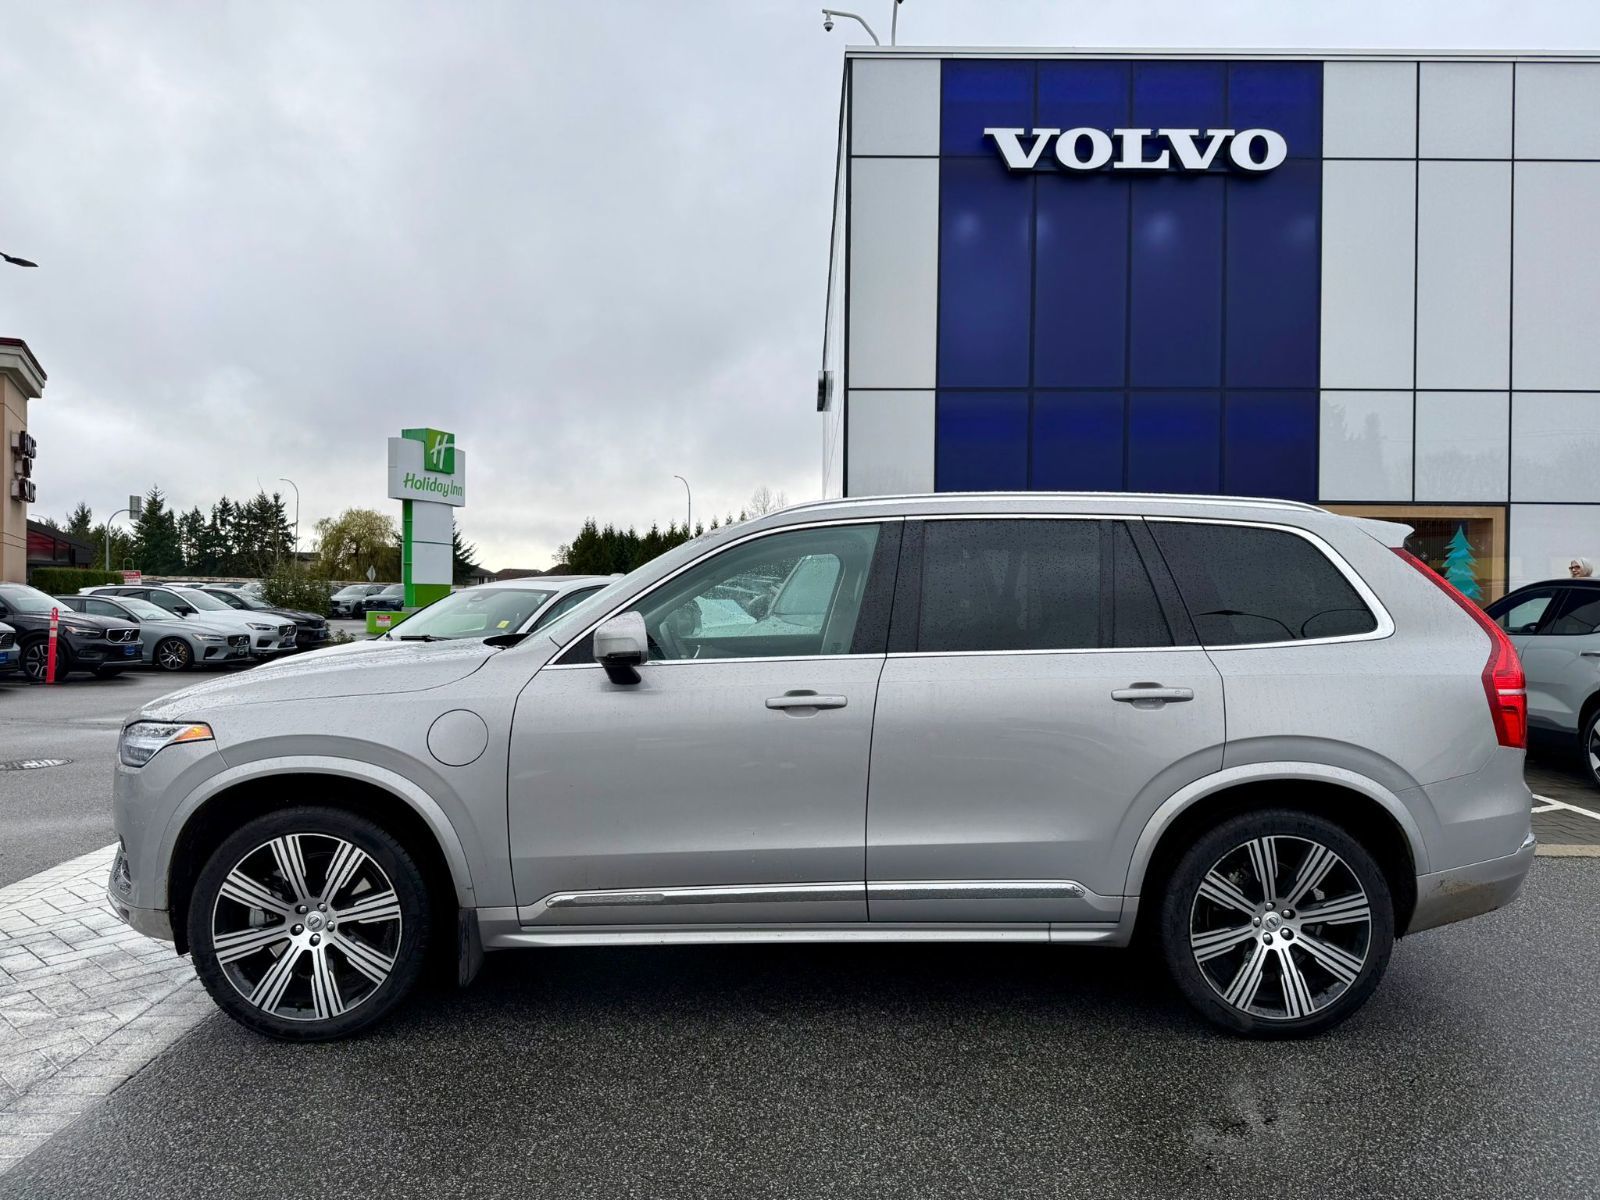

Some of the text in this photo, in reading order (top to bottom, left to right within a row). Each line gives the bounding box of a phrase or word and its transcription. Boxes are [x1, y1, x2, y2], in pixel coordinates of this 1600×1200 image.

[983, 127, 1288, 171] VOLVO
[404, 472, 463, 497] Holiday Inn
